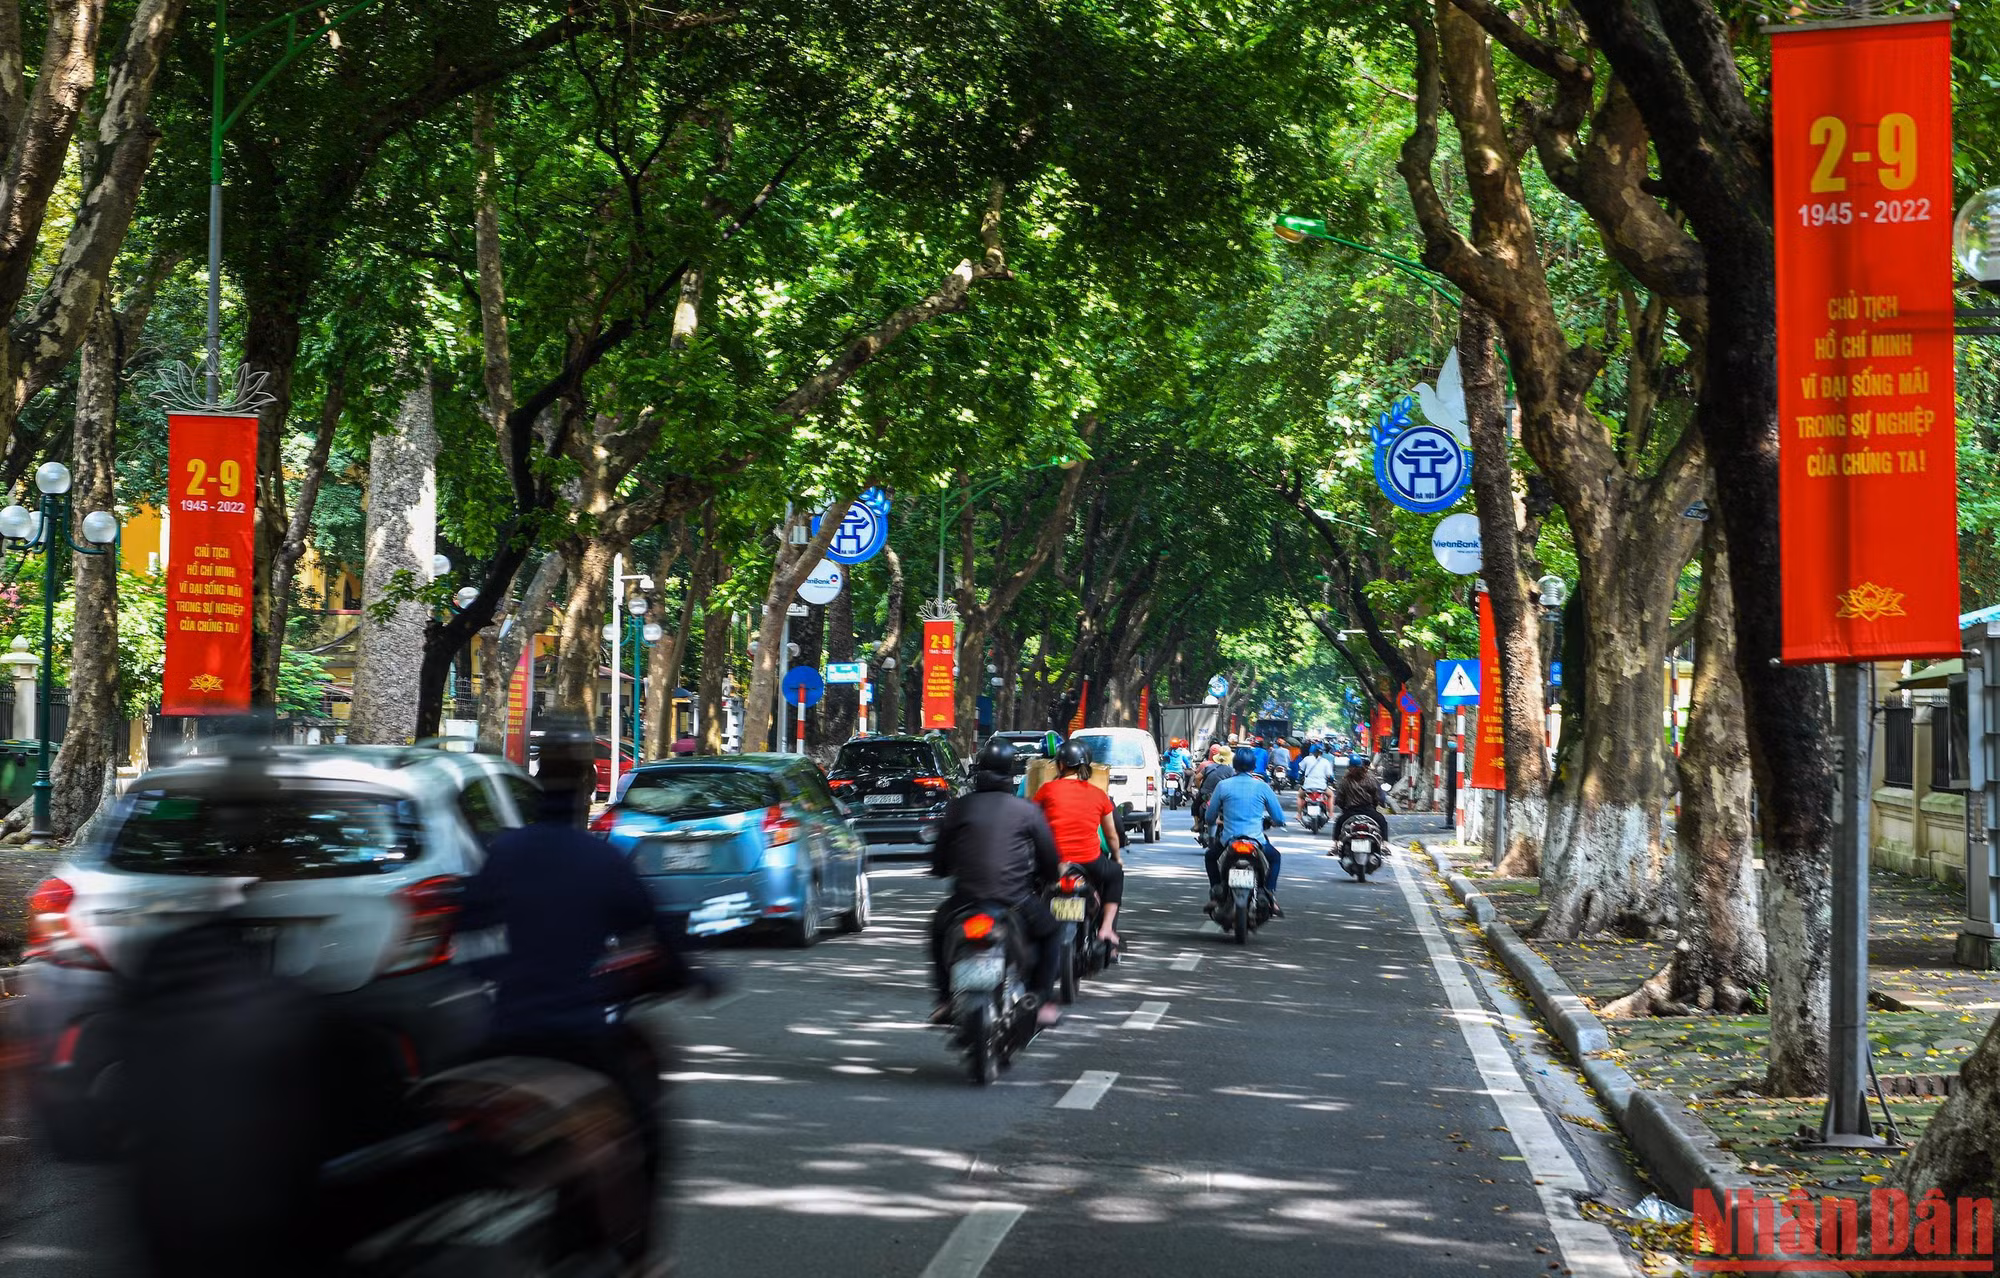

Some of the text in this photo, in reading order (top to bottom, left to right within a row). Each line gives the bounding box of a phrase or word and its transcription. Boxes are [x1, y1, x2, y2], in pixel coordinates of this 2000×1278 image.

[1809, 112, 1917, 193] 2-9
[1798, 202, 1853, 227] 1945
[1874, 198, 1931, 223] 2022
[1828, 290, 1898, 322] CHỦ TỊCH
[1814, 329, 1913, 360] HỒ CHÍ MINH
[1801, 366, 1930, 401] VĨ ĐẠI SỐNG MÃI
[1796, 405, 1935, 439] TRONG SỰ NGHIỆP
[1807, 446, 1926, 477] CỦA CHÚNG TA!
[186, 458, 241, 497] 2-9
[180, 500, 208, 512] 1945
[217, 501, 246, 514] 2022
[194, 544, 230, 560] CHỦ TỊCH
[200, 563, 213, 576] CHÍ
[214, 566, 236, 578] MINH
[176, 601, 202, 613] TRONG
[180, 616, 196, 631] CỦA
